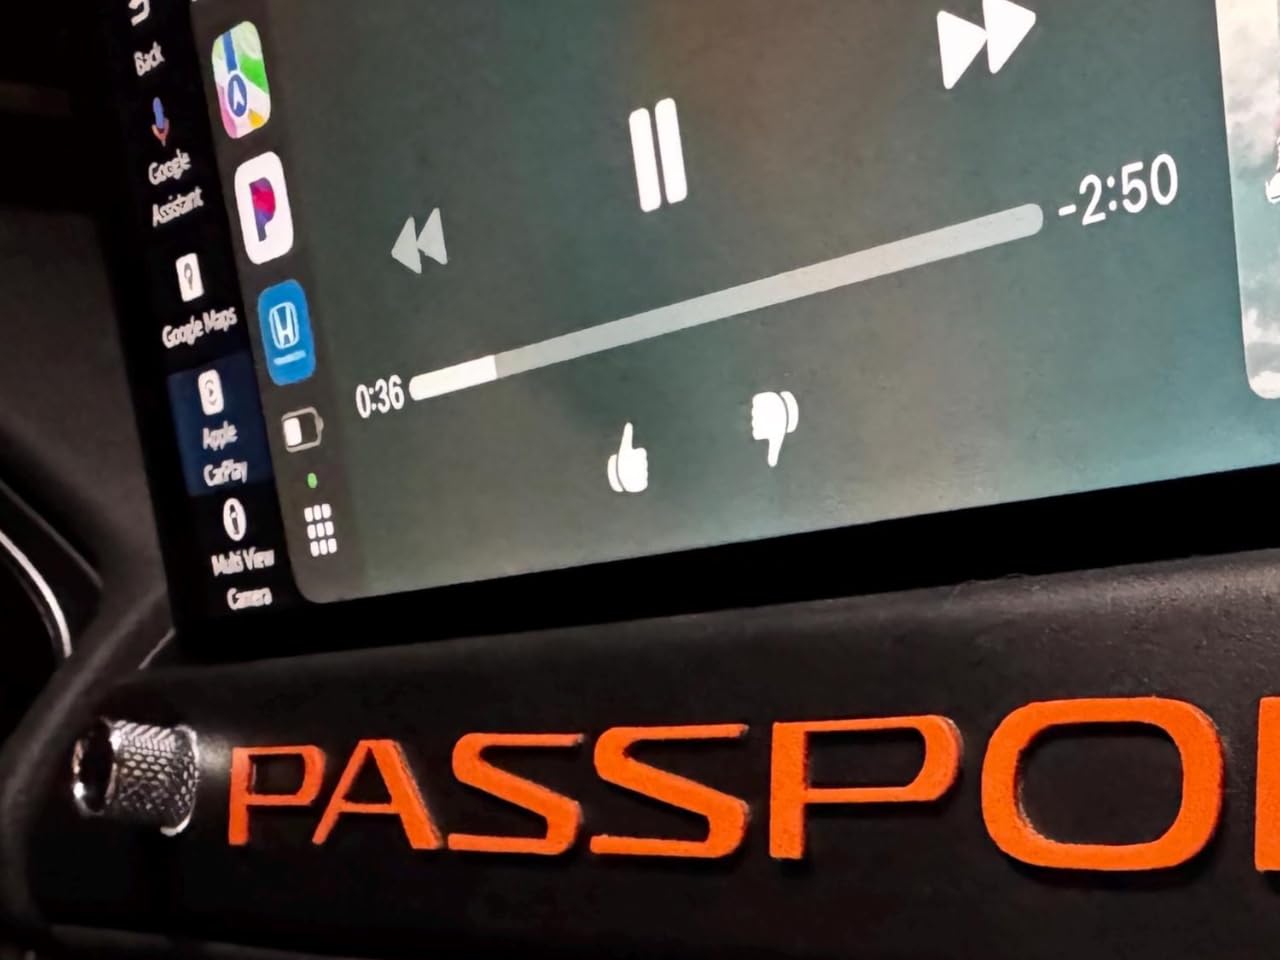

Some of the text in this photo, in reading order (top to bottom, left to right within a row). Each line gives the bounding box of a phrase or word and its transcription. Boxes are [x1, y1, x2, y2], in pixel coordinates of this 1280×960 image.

[134, 41, 165, 76] Back
[148, 149, 191, 186] Google
[152, 186, 204, 227] Assistant
[1057, 152, 1179, 226] -2:50
[162, 306, 238, 349] Google Maps
[355, 374, 406, 419] 0:36
[203, 420, 238, 451] Apple
[203, 459, 248, 487] CarPlay
[211, 546, 275, 576] Multi View
